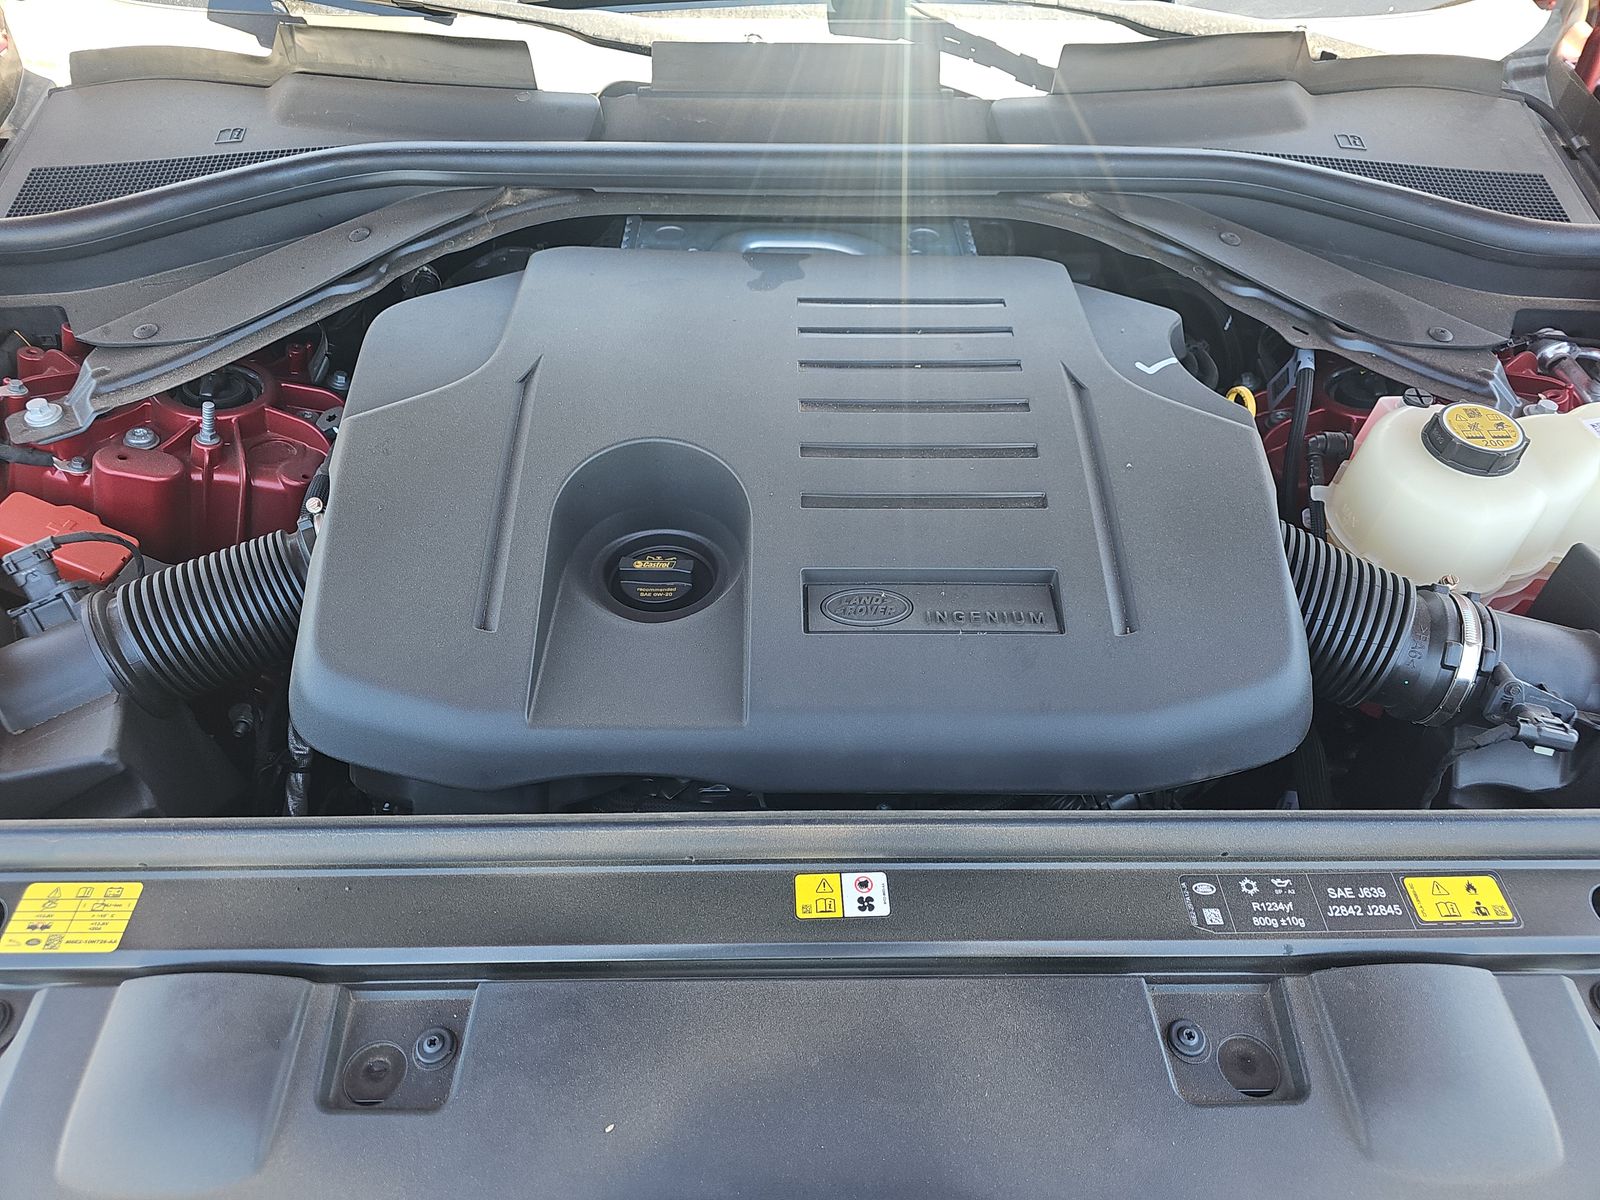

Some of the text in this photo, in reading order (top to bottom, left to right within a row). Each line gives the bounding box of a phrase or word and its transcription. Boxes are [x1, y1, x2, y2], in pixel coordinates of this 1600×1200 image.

[1481, 439, 1505, 447] 200
[847, 605, 897, 616] ROVER
[925, 611, 1046, 625] INGENIUM
[1327, 887, 1386, 899] SAE J639
[1252, 902, 1294, 914] R1234yf
[1327, 905, 1402, 917] J2842 J2845
[1252, 916, 1306, 927] 800g ±10g
